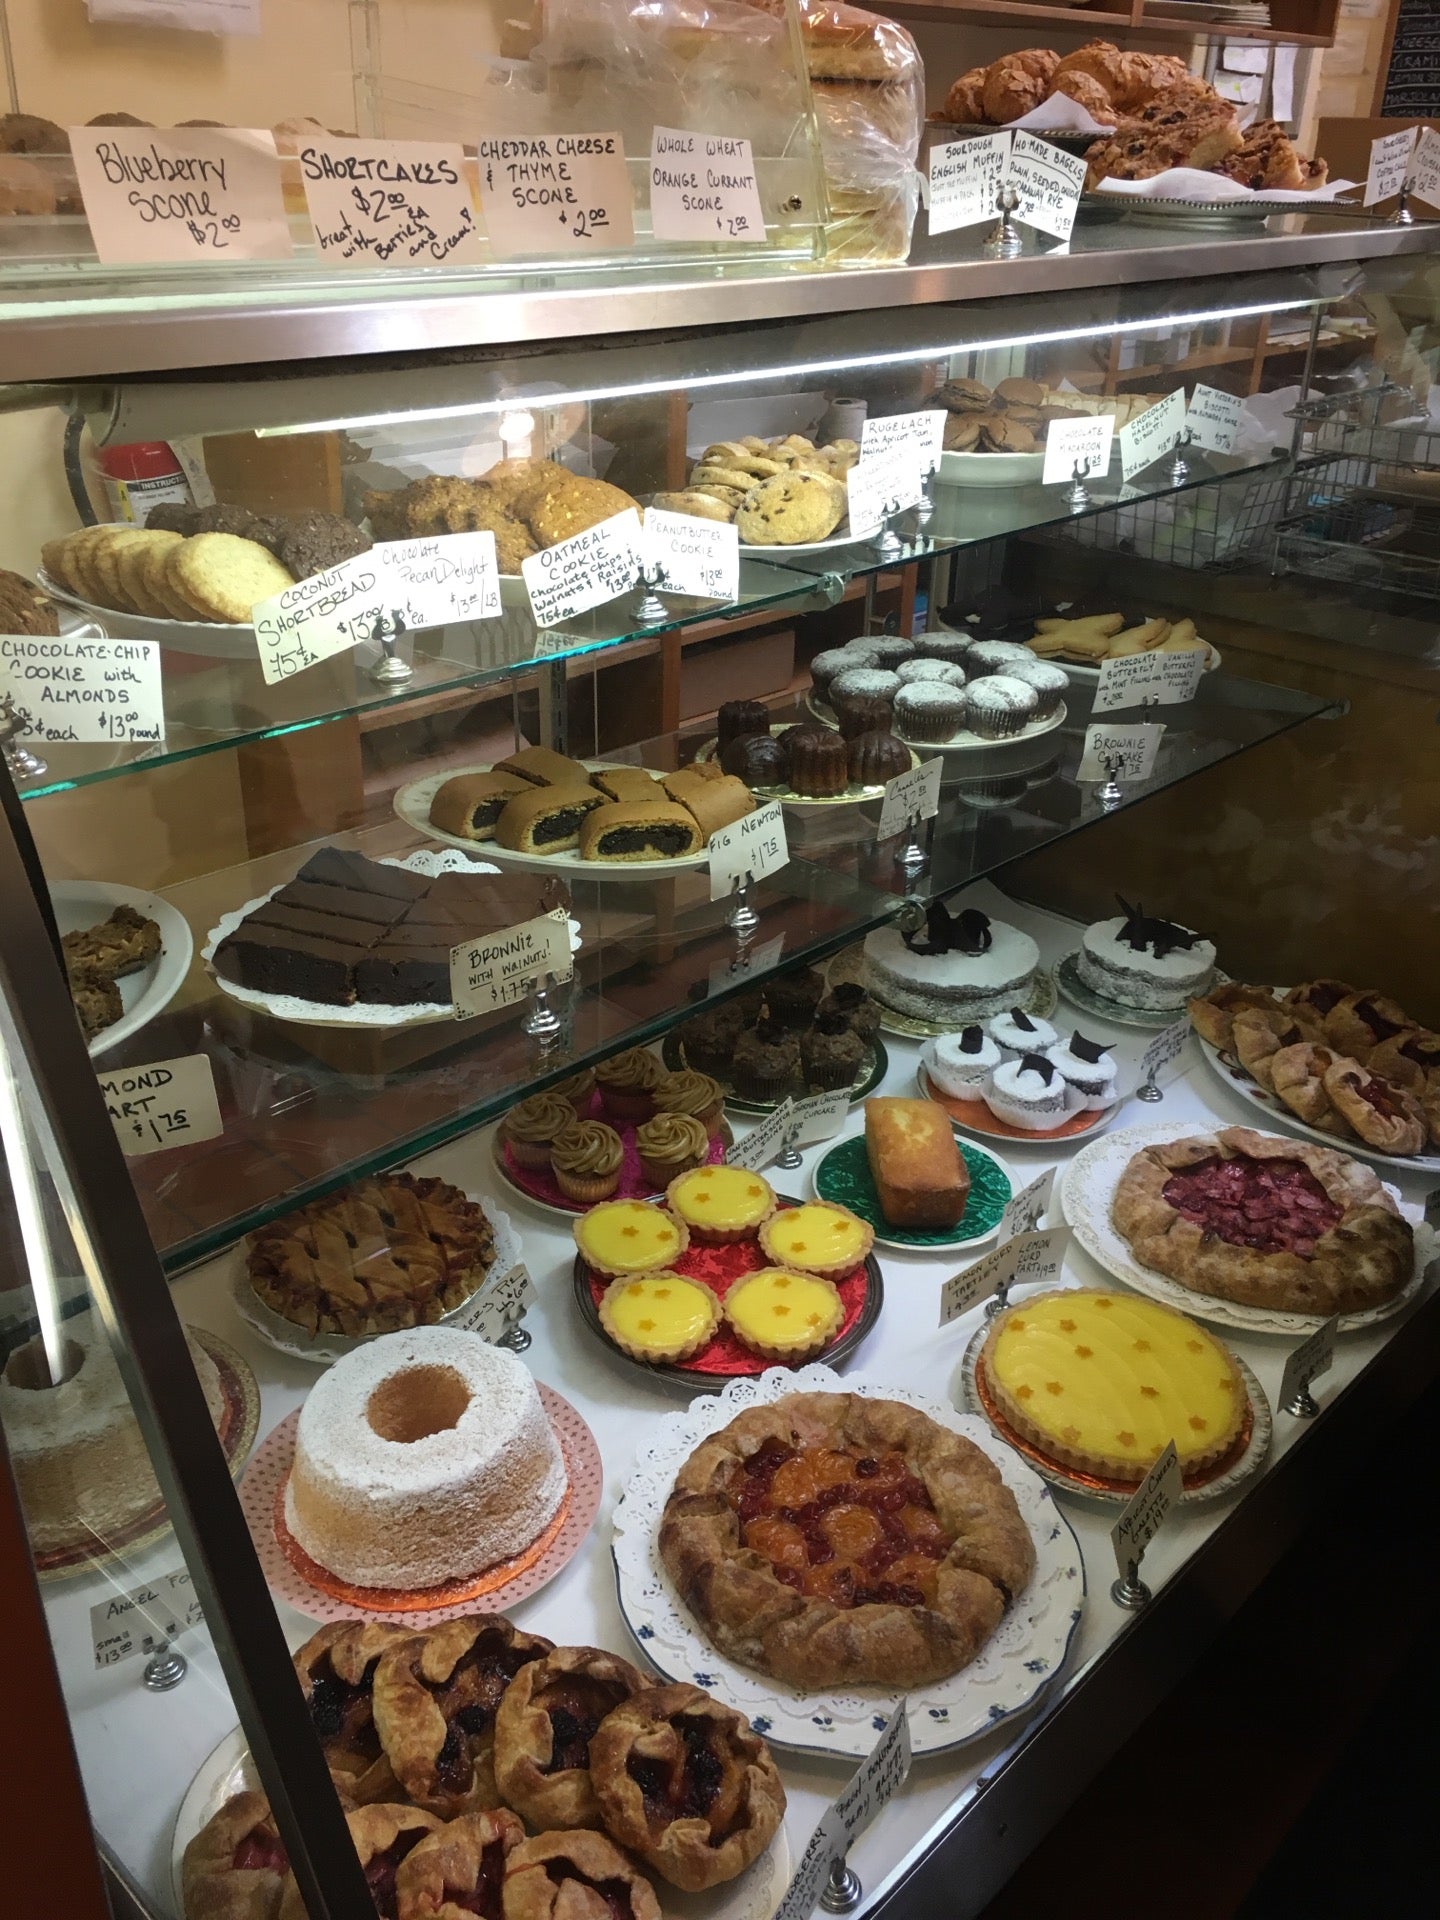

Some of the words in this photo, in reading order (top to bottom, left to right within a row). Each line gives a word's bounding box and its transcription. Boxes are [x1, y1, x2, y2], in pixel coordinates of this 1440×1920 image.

[481, 139, 549, 160] CHEDDAR
[557, 138, 615, 157] CHEESE
[656, 136, 694, 154] WHOLE
[706, 139, 744, 158] WHEAT
[96, 142, 227, 189] Blueberry
[301, 148, 459, 184] SHORTCAKES
[507, 162, 571, 182] THYME
[931, 160, 968, 181] ENGLISH
[973, 151, 1004, 169] MUFFIN
[653, 168, 698, 189] ORANGE
[707, 168, 754, 190] CURRANT
[129, 190, 217, 222] Scone
[512, 187, 577, 207] SCONE
[682, 197, 723, 211] SCONE
[1047, 193, 1064, 209] RYE
[1131, 394, 1176, 429] CHOCOLATE
[869, 414, 932, 434] RUGELACH
[1131, 407, 1169, 439] HAZELNUT
[382, 540, 440, 566] Chocolate
[540, 528, 611, 568] OATMEAL
[670, 540, 714, 558] COOKIE
[549, 546, 608, 581] COOKIE
[280, 562, 350, 611] COCONUT
[530, 570, 589, 599] chocolate
[590, 554, 622, 573] chips
[662, 581, 687, 592] each
[534, 584, 584, 612] Walnuts
[258, 573, 376, 647] SHORTBREAD
[10, 659, 86, 682] COOKIE
[104, 666, 142, 683] with
[1106, 664, 1154, 680] BUTTERFLY
[1113, 654, 1157, 668] CHOCOLATE
[41, 686, 130, 704] ALMONDS
[1111, 679, 1127, 690] MINT
[46, 725, 79, 741] each
[129, 723, 161, 742] pound
[1093, 733, 1146, 751] BROWNIE
[709, 831, 732, 854] FIG
[741, 804, 782, 838] NEWTON
[803, 1105, 836, 1120] CUPCAKE
[727, 1132, 757, 1156] VANILLA
[1018, 1238, 1051, 1254] LEMON
[947, 1265, 983, 1292] LEMON
[107, 1591, 159, 1620] ANGEL
